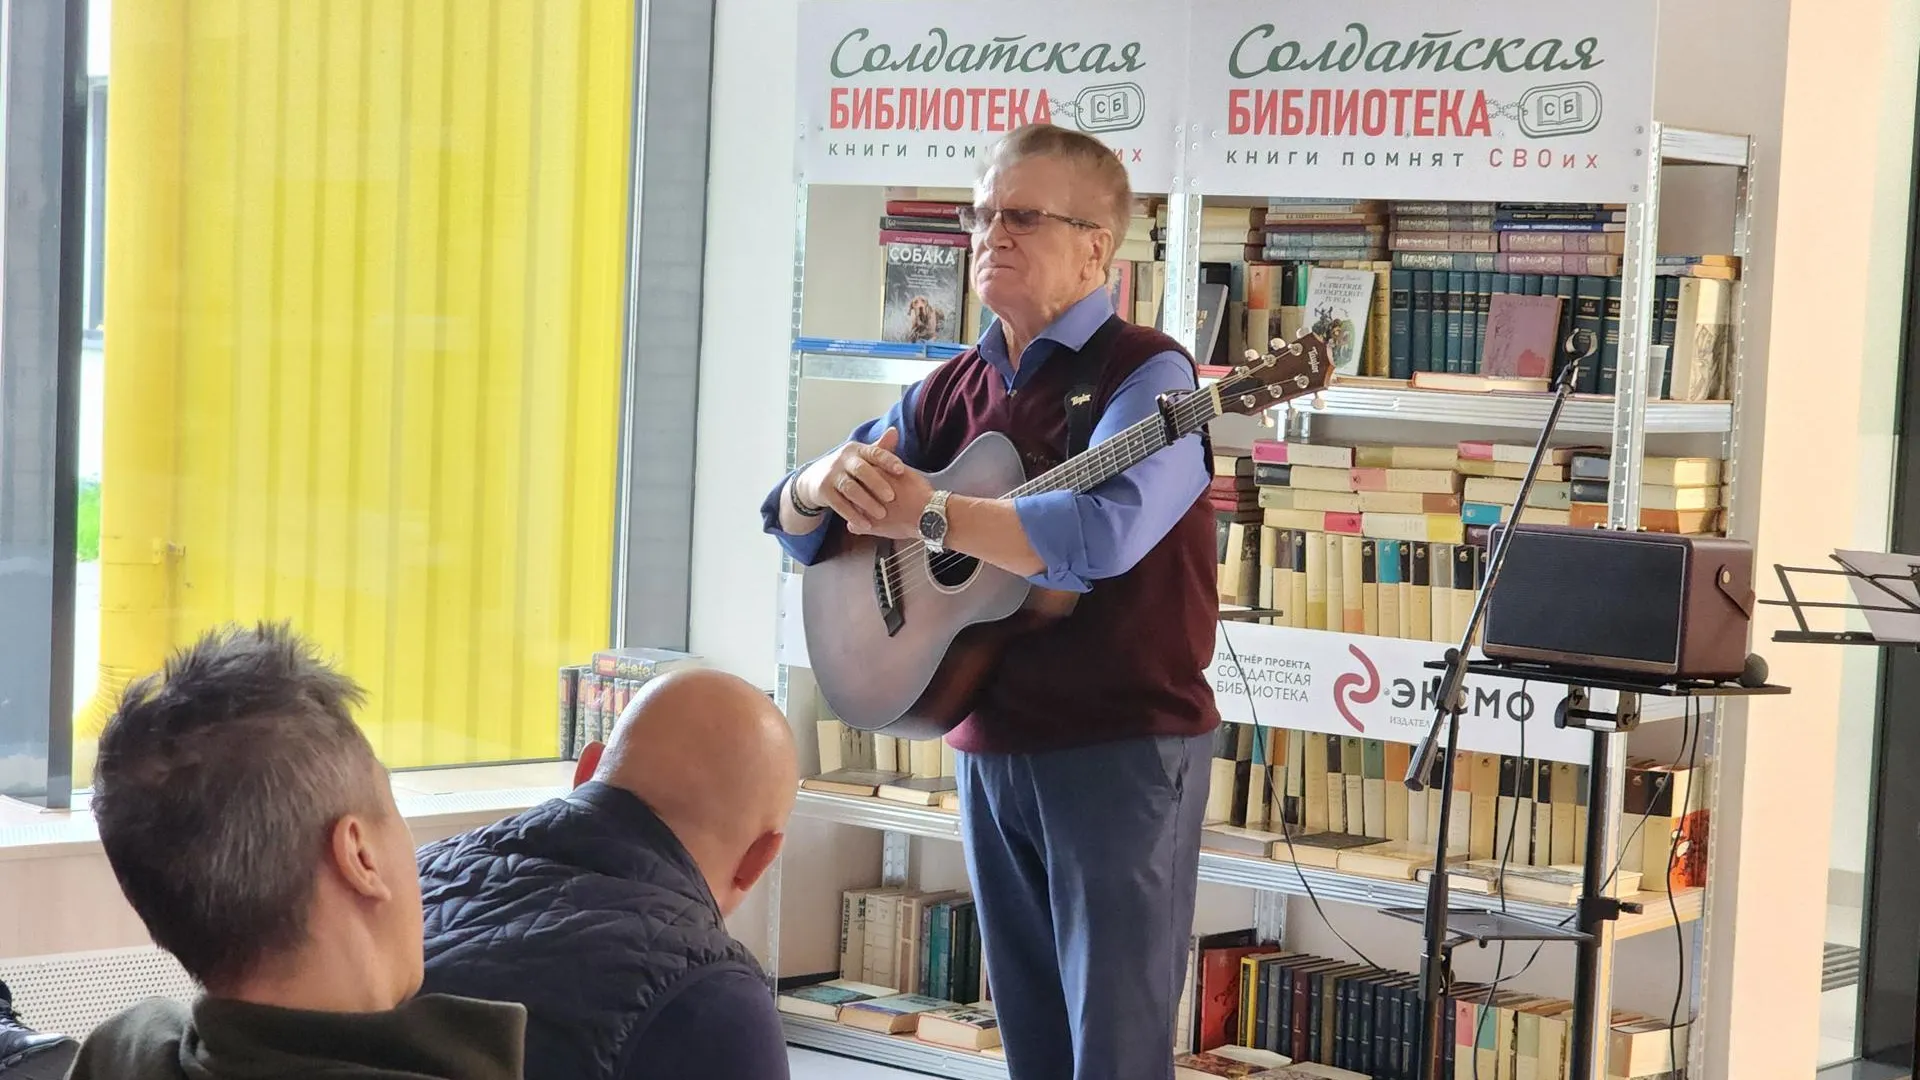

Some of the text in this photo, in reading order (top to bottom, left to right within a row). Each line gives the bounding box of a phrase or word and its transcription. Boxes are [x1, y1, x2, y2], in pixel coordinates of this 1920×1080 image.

[830, 27, 1147, 78] Солдатская
[1228, 22, 1605, 79] Солдатская
[830, 87, 1052, 131] БИБЛИОТЕКА
[1228, 89, 1492, 137] БИБЛИОТЕКА
[889, 246, 956, 265] СОБАКА
[1308, 346, 1320, 373] Taylor
[1218, 652, 1311, 670] ПАТНЁР ПРОЕКТА
